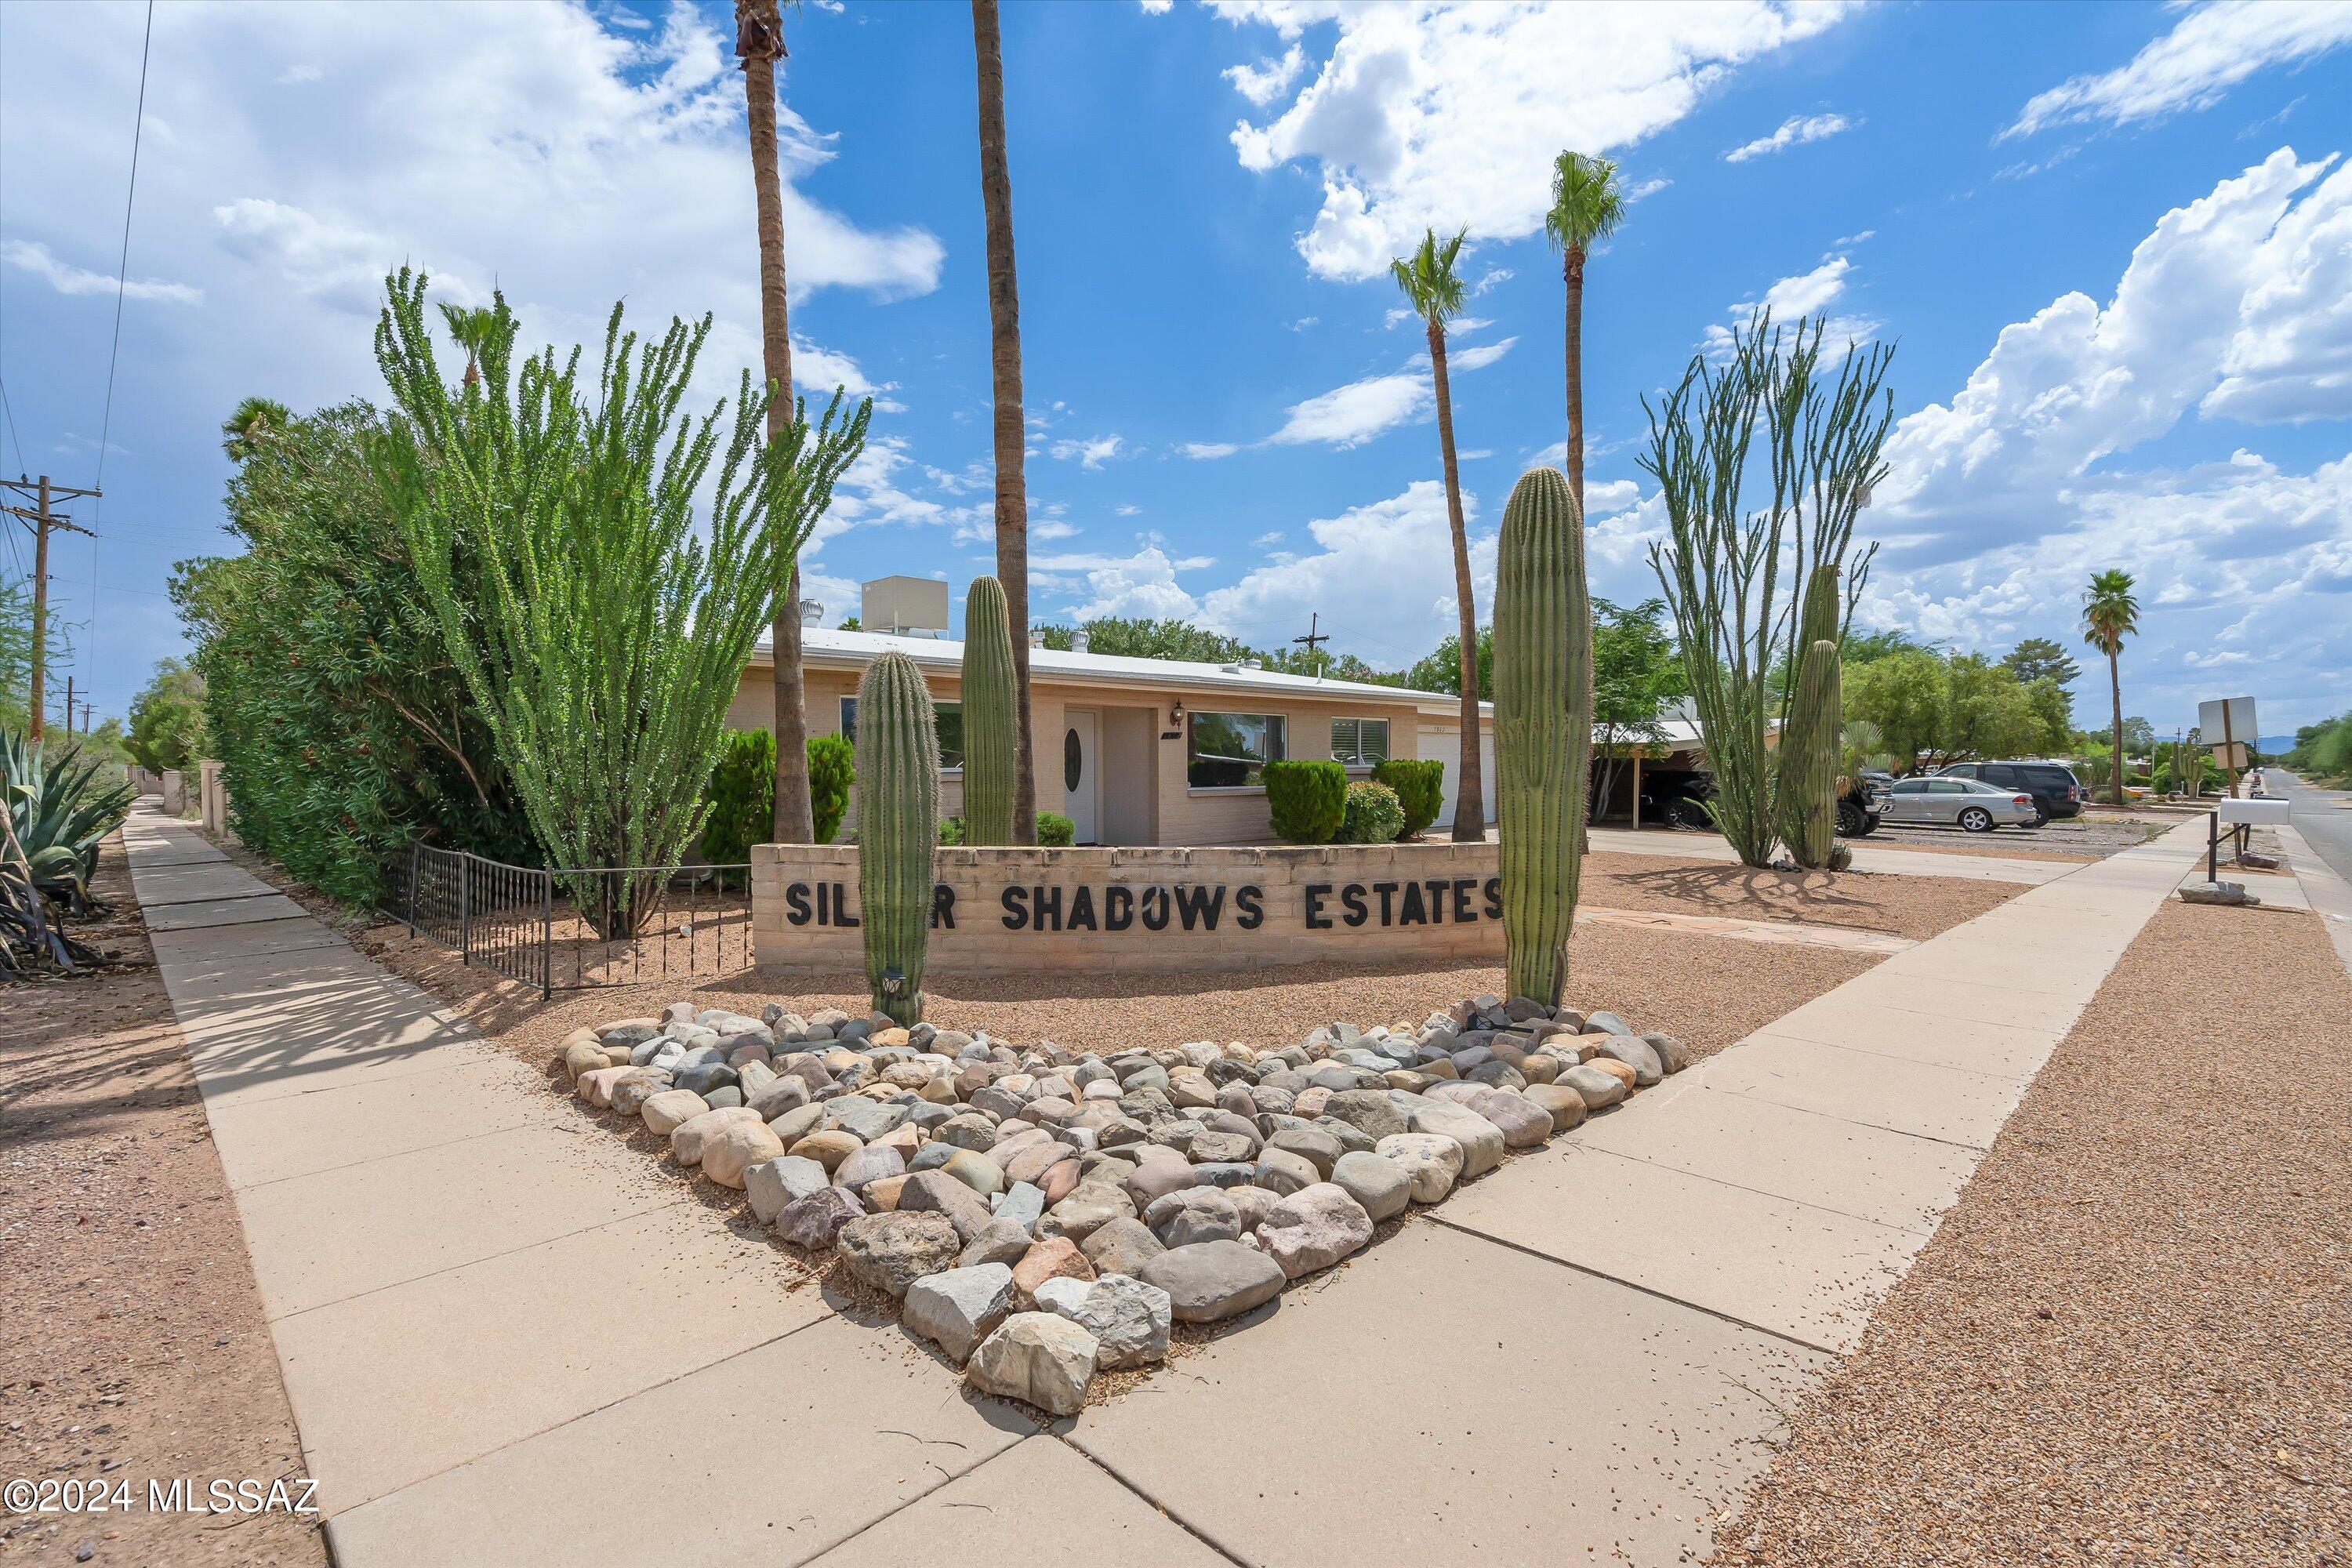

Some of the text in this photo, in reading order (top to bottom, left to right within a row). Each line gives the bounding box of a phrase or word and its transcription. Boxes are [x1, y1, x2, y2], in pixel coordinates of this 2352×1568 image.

[786, 877, 1503, 931] SILR SHADOWS ESTATES
